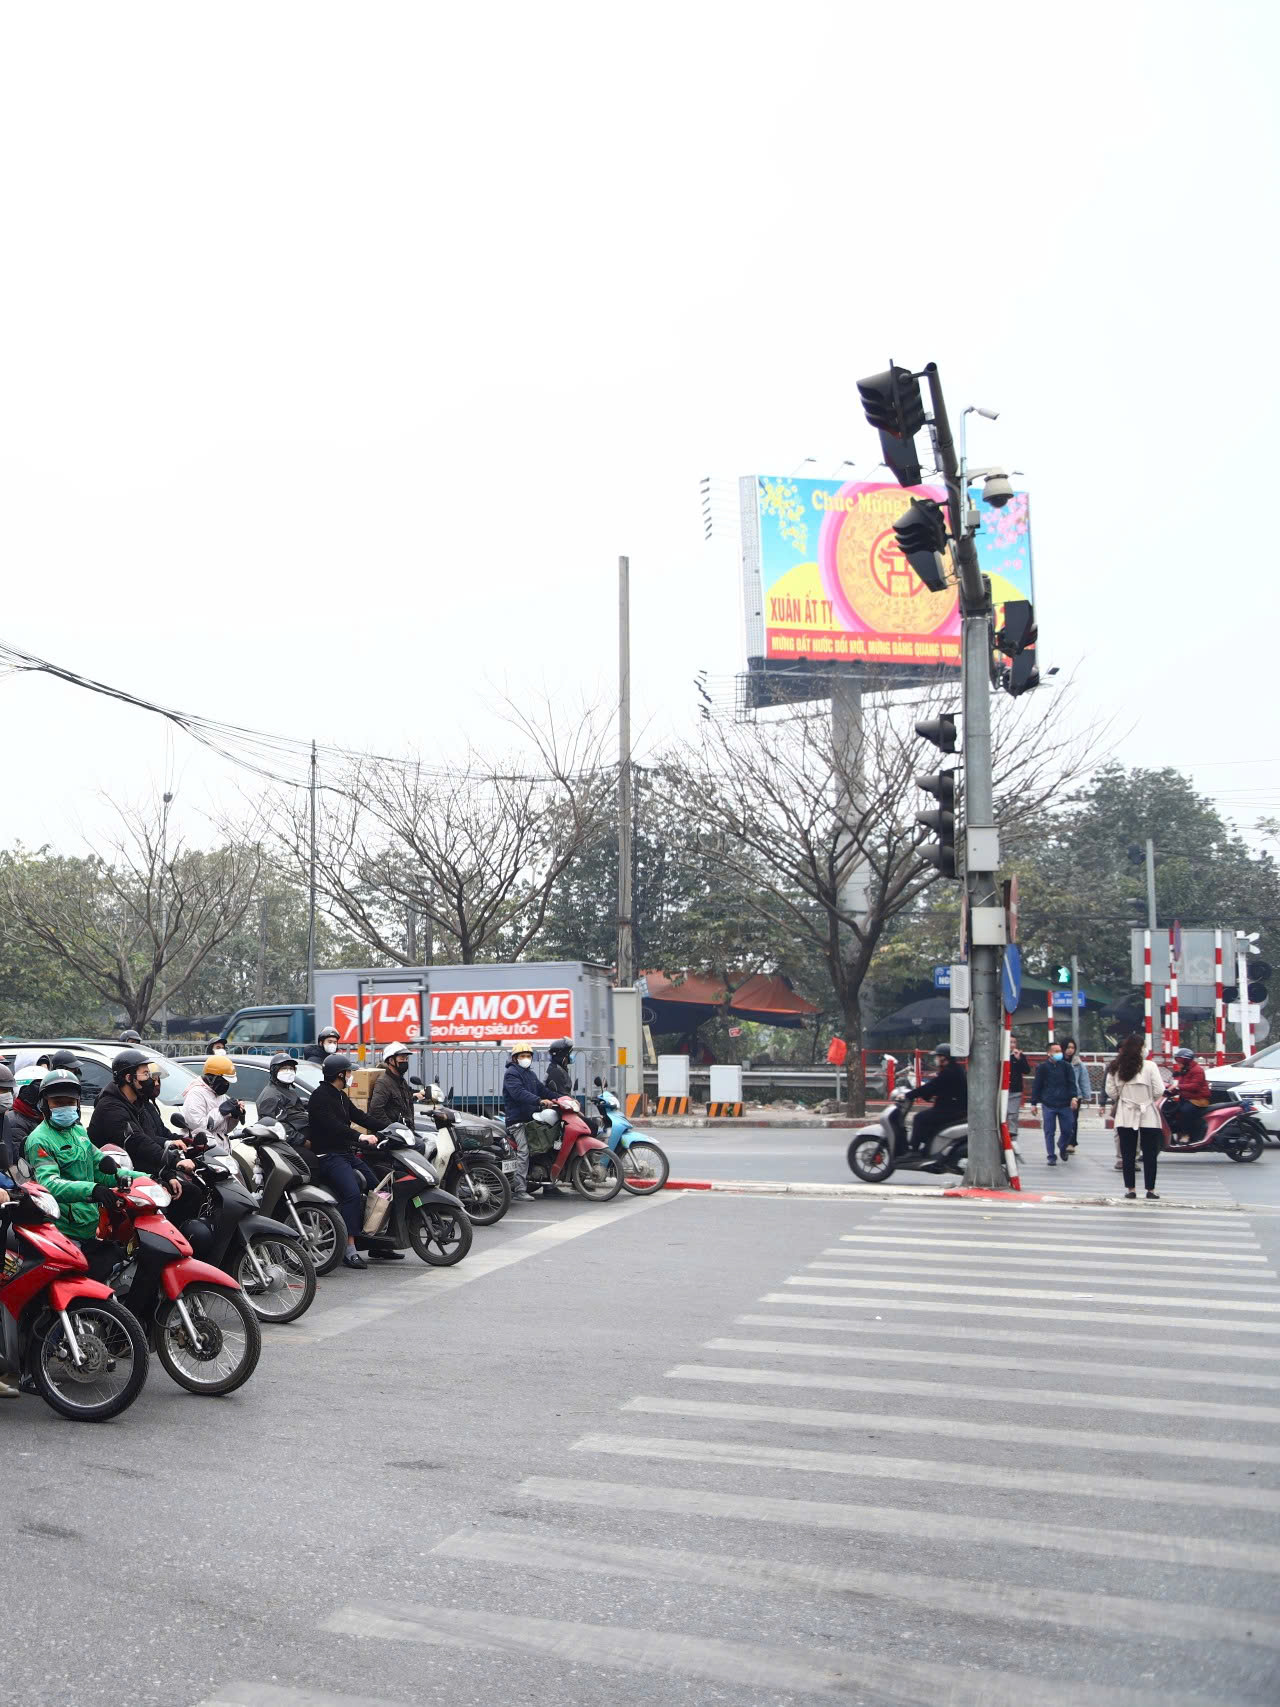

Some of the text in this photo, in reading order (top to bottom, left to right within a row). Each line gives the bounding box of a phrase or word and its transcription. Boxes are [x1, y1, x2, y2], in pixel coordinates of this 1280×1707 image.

[770, 592, 801, 623] XUÂN
[379, 993, 570, 1023] LALAMOVE
[449, 1021, 487, 1039] hàng
